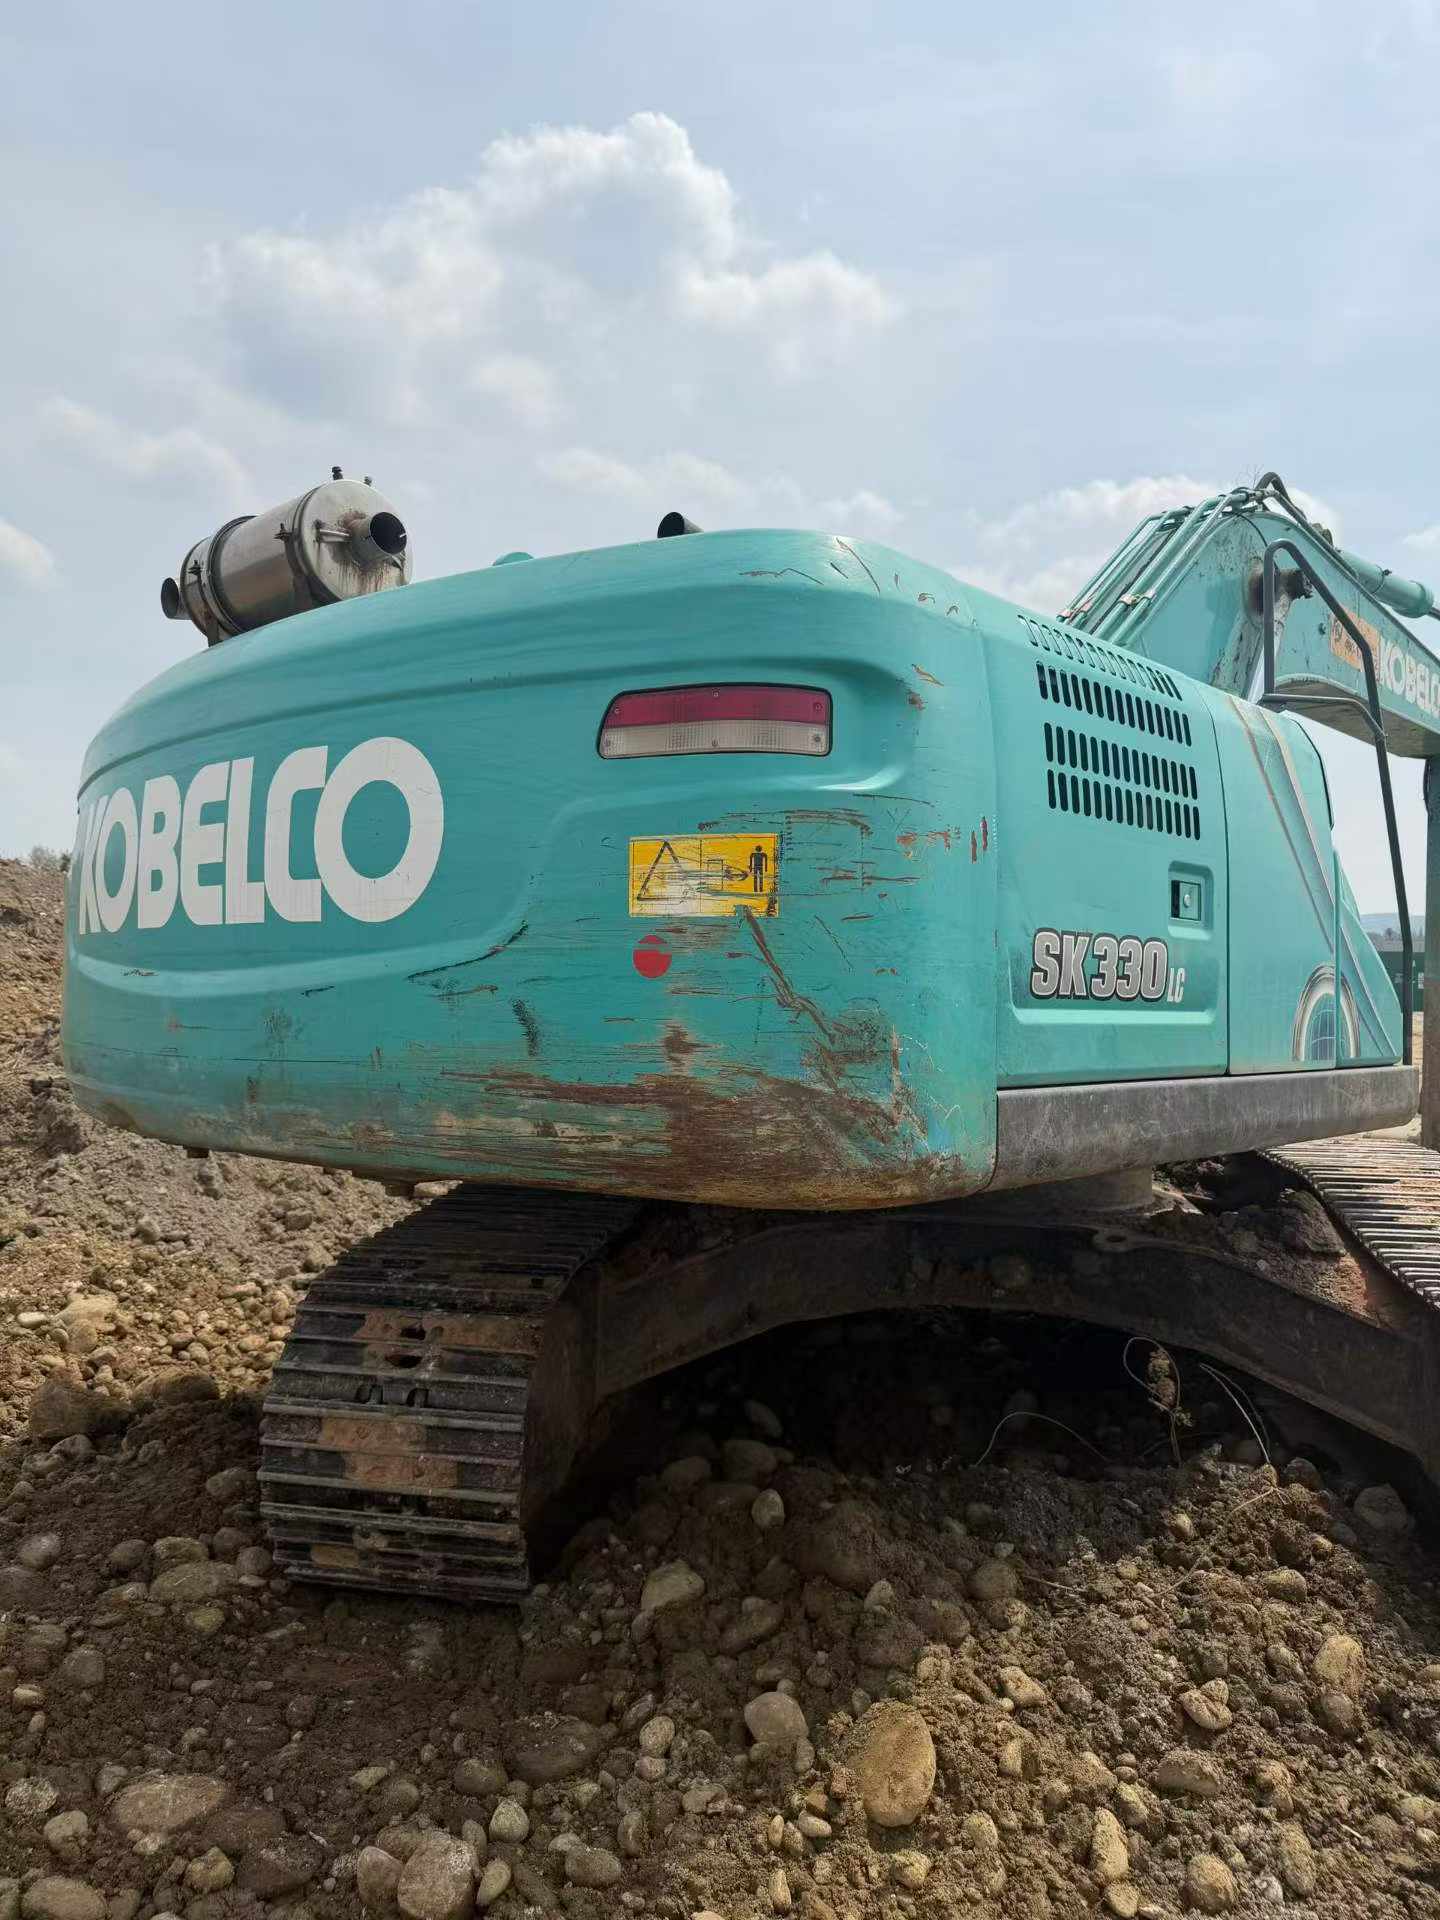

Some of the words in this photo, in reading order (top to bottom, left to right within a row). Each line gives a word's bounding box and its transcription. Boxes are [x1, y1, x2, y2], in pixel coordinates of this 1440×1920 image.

[1379, 634, 1440, 720] KOBELC
[79, 736, 444, 935] KOBELCO
[1031, 929, 1168, 1002] SK330
[1166, 967, 1186, 1004] LC
